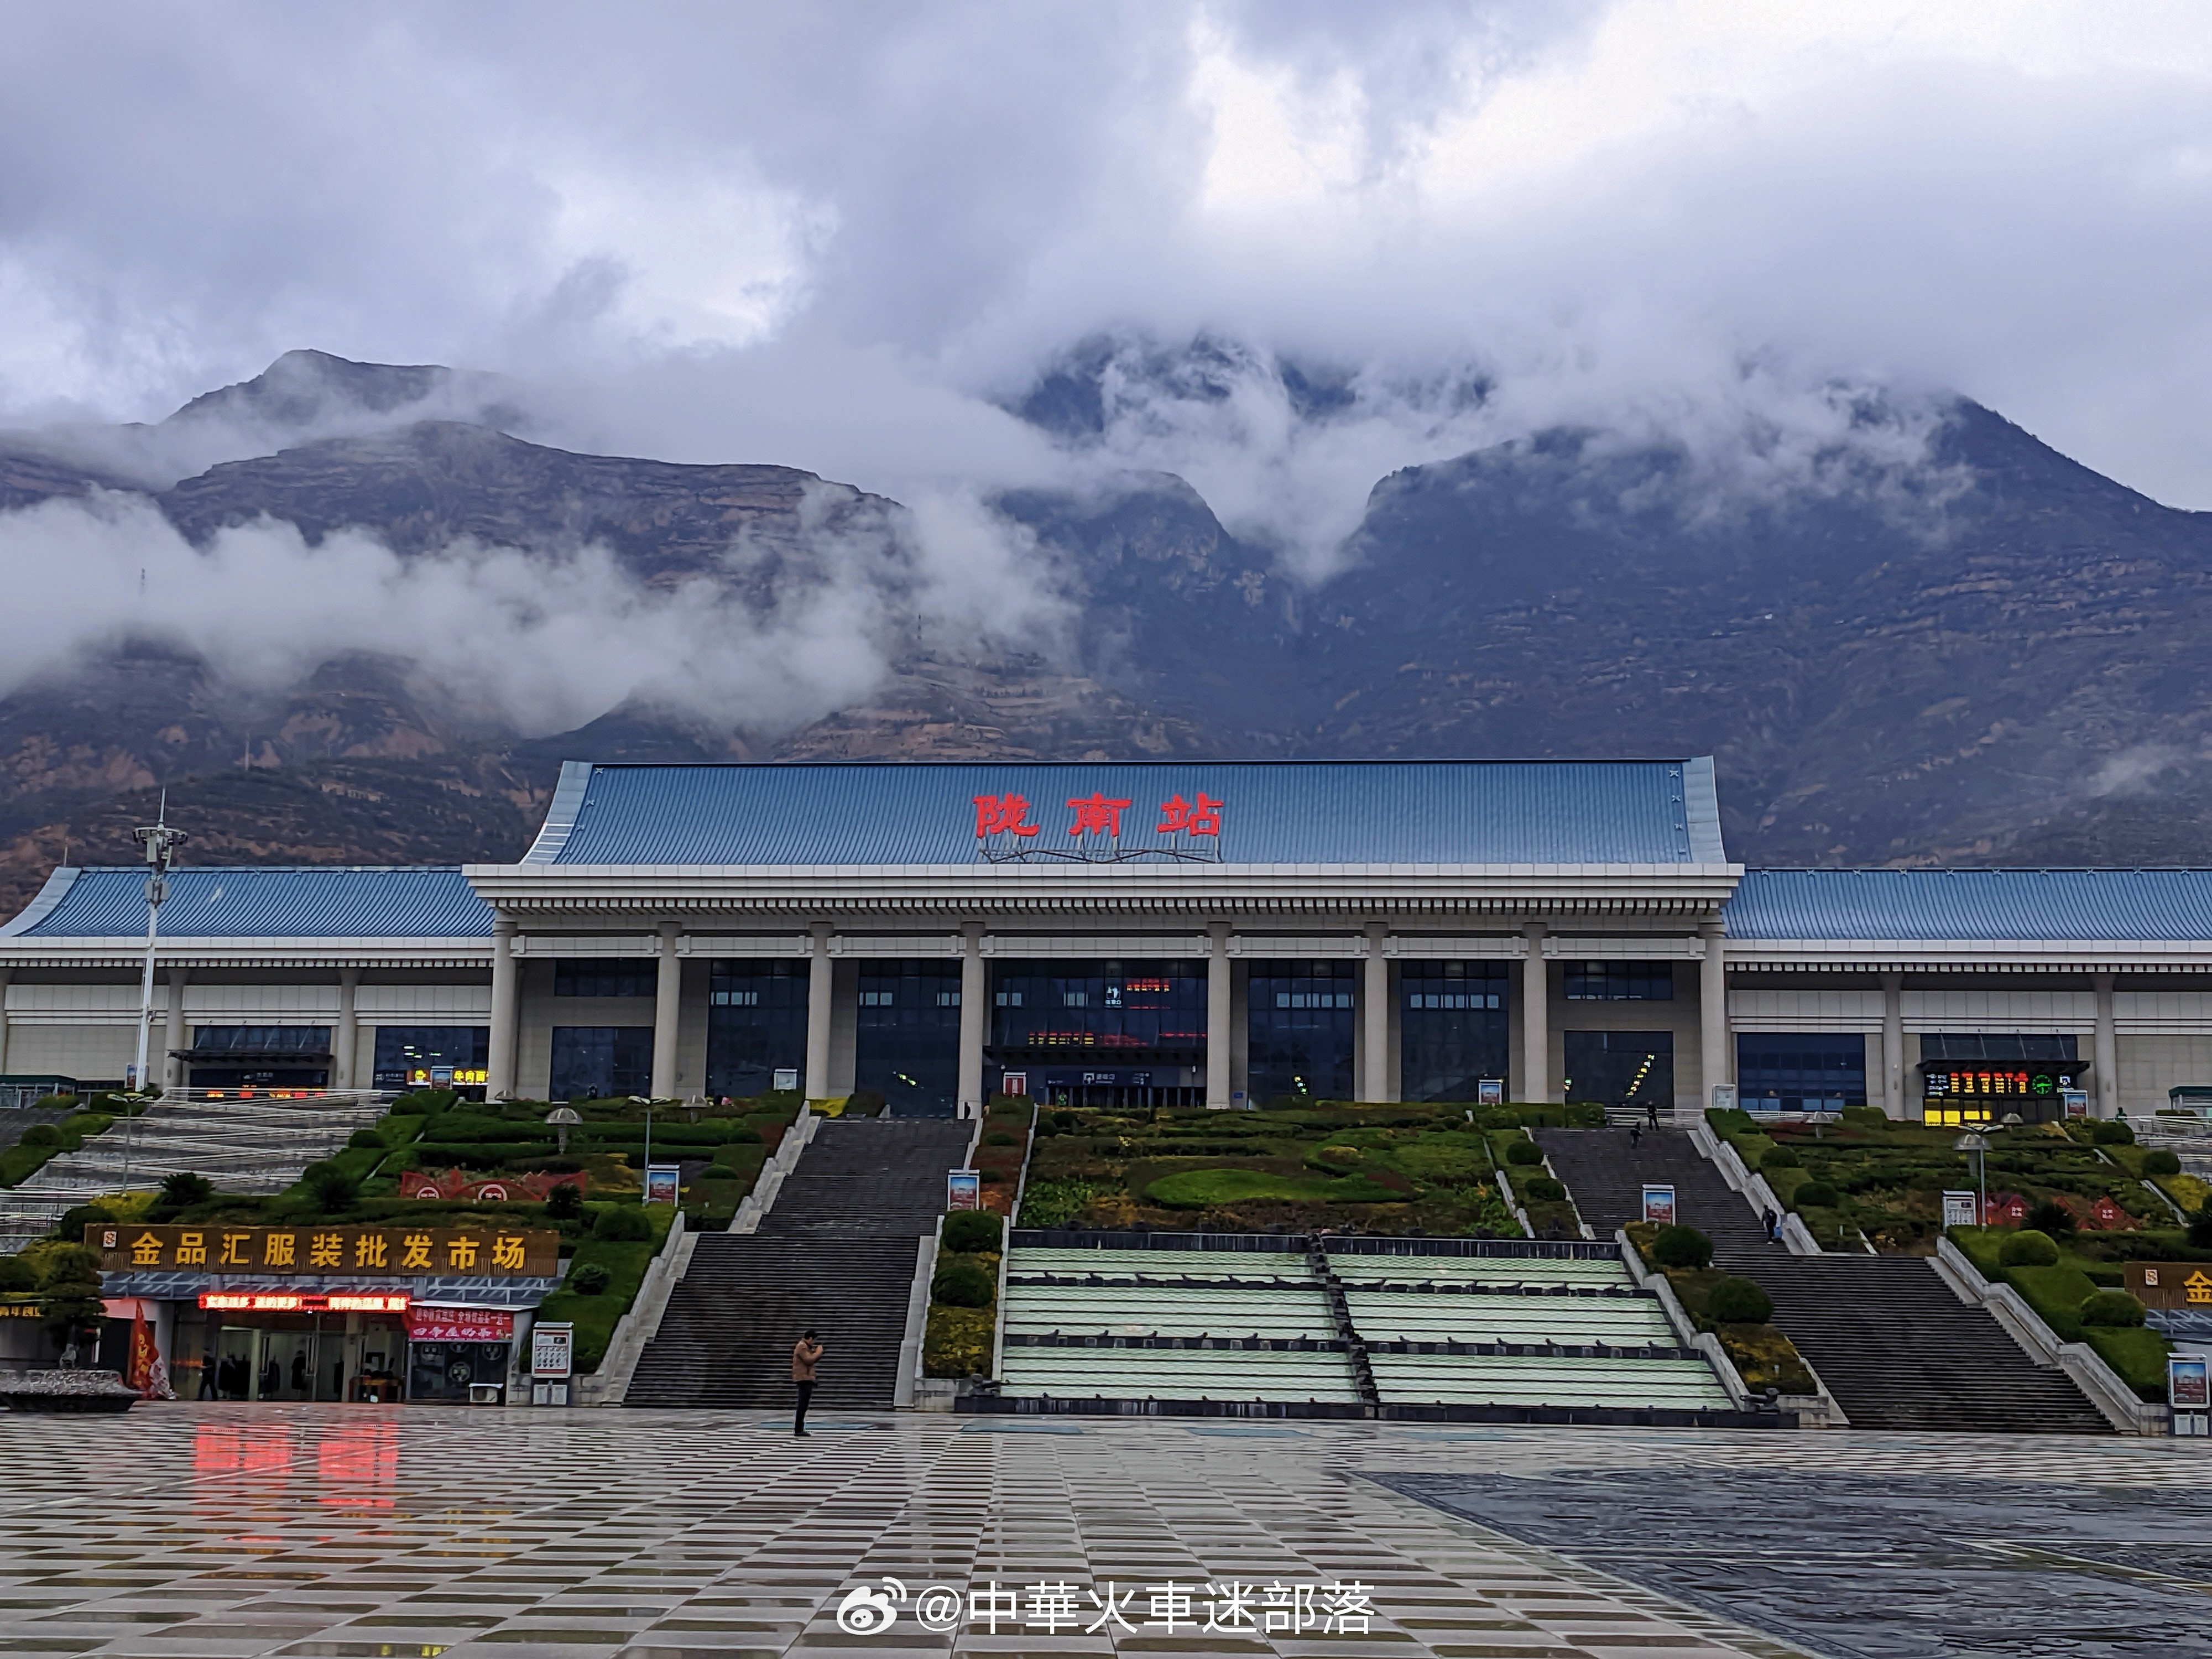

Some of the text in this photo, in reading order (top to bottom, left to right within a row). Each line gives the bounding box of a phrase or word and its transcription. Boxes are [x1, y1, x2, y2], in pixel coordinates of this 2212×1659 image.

[973, 792, 1223, 838] 陇南站
[132, 1232, 525, 1269] 金品汇服装批发市场
